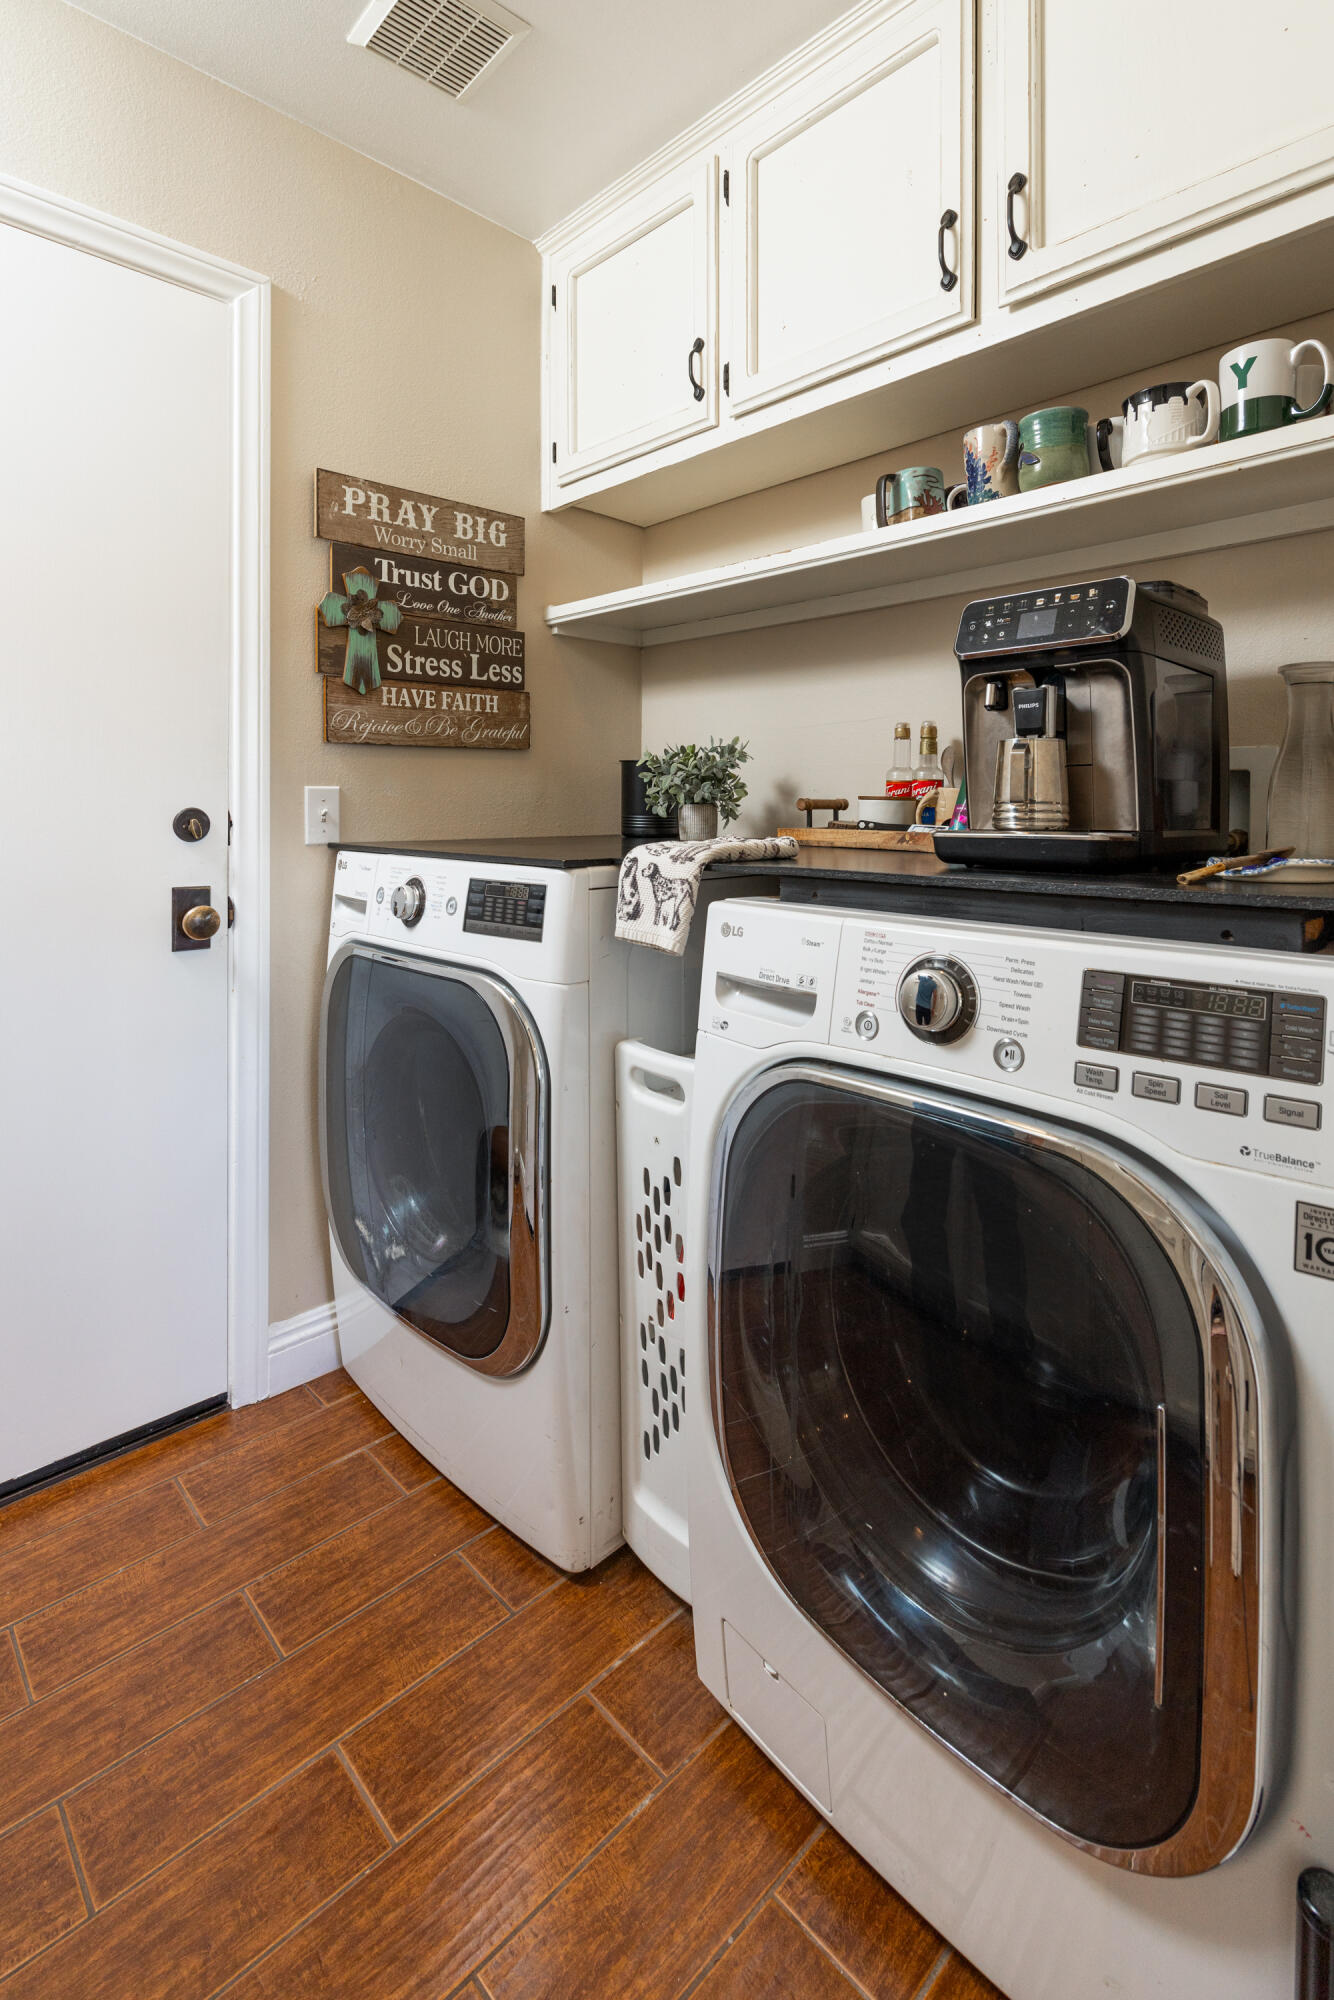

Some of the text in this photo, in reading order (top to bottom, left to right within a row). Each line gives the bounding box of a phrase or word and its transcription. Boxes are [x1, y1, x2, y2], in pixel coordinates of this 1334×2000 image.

[1230, 356, 1258, 391] Y
[342, 485, 507, 547] PRAY BIG
[374, 526, 477, 561] Worry Small
[374, 557, 509, 601] Trust GOD
[395, 591, 513, 622] Love One Another
[415, 626, 522, 657] LAUGH MORE
[386, 644, 522, 684] Stress Less
[382, 687, 499, 713] HAVE FAITH
[1018, 702, 1040, 710] PHILIPS
[331, 708, 404, 741] Rejoice
[425, 714, 458, 736] Be
[462, 715, 528, 742] Grateful
[732, 926, 744, 937] LG
[758, 971, 790, 984] Direct Drive
[1010, 967, 1034, 976] Delicates
[1013, 990, 1032, 998] Towels
[1016, 1004, 1030, 1012] Wash
[1085, 1067, 1104, 1077] Wash
[1148, 1079, 1164, 1089] Spin
[1144, 1086, 1167, 1097] Speed
[1213, 1090, 1228, 1101] Soil
[1210, 1098, 1231, 1111] Level
[1278, 1106, 1304, 1119] Signal
[1303, 1211, 1327, 1224] Direct
